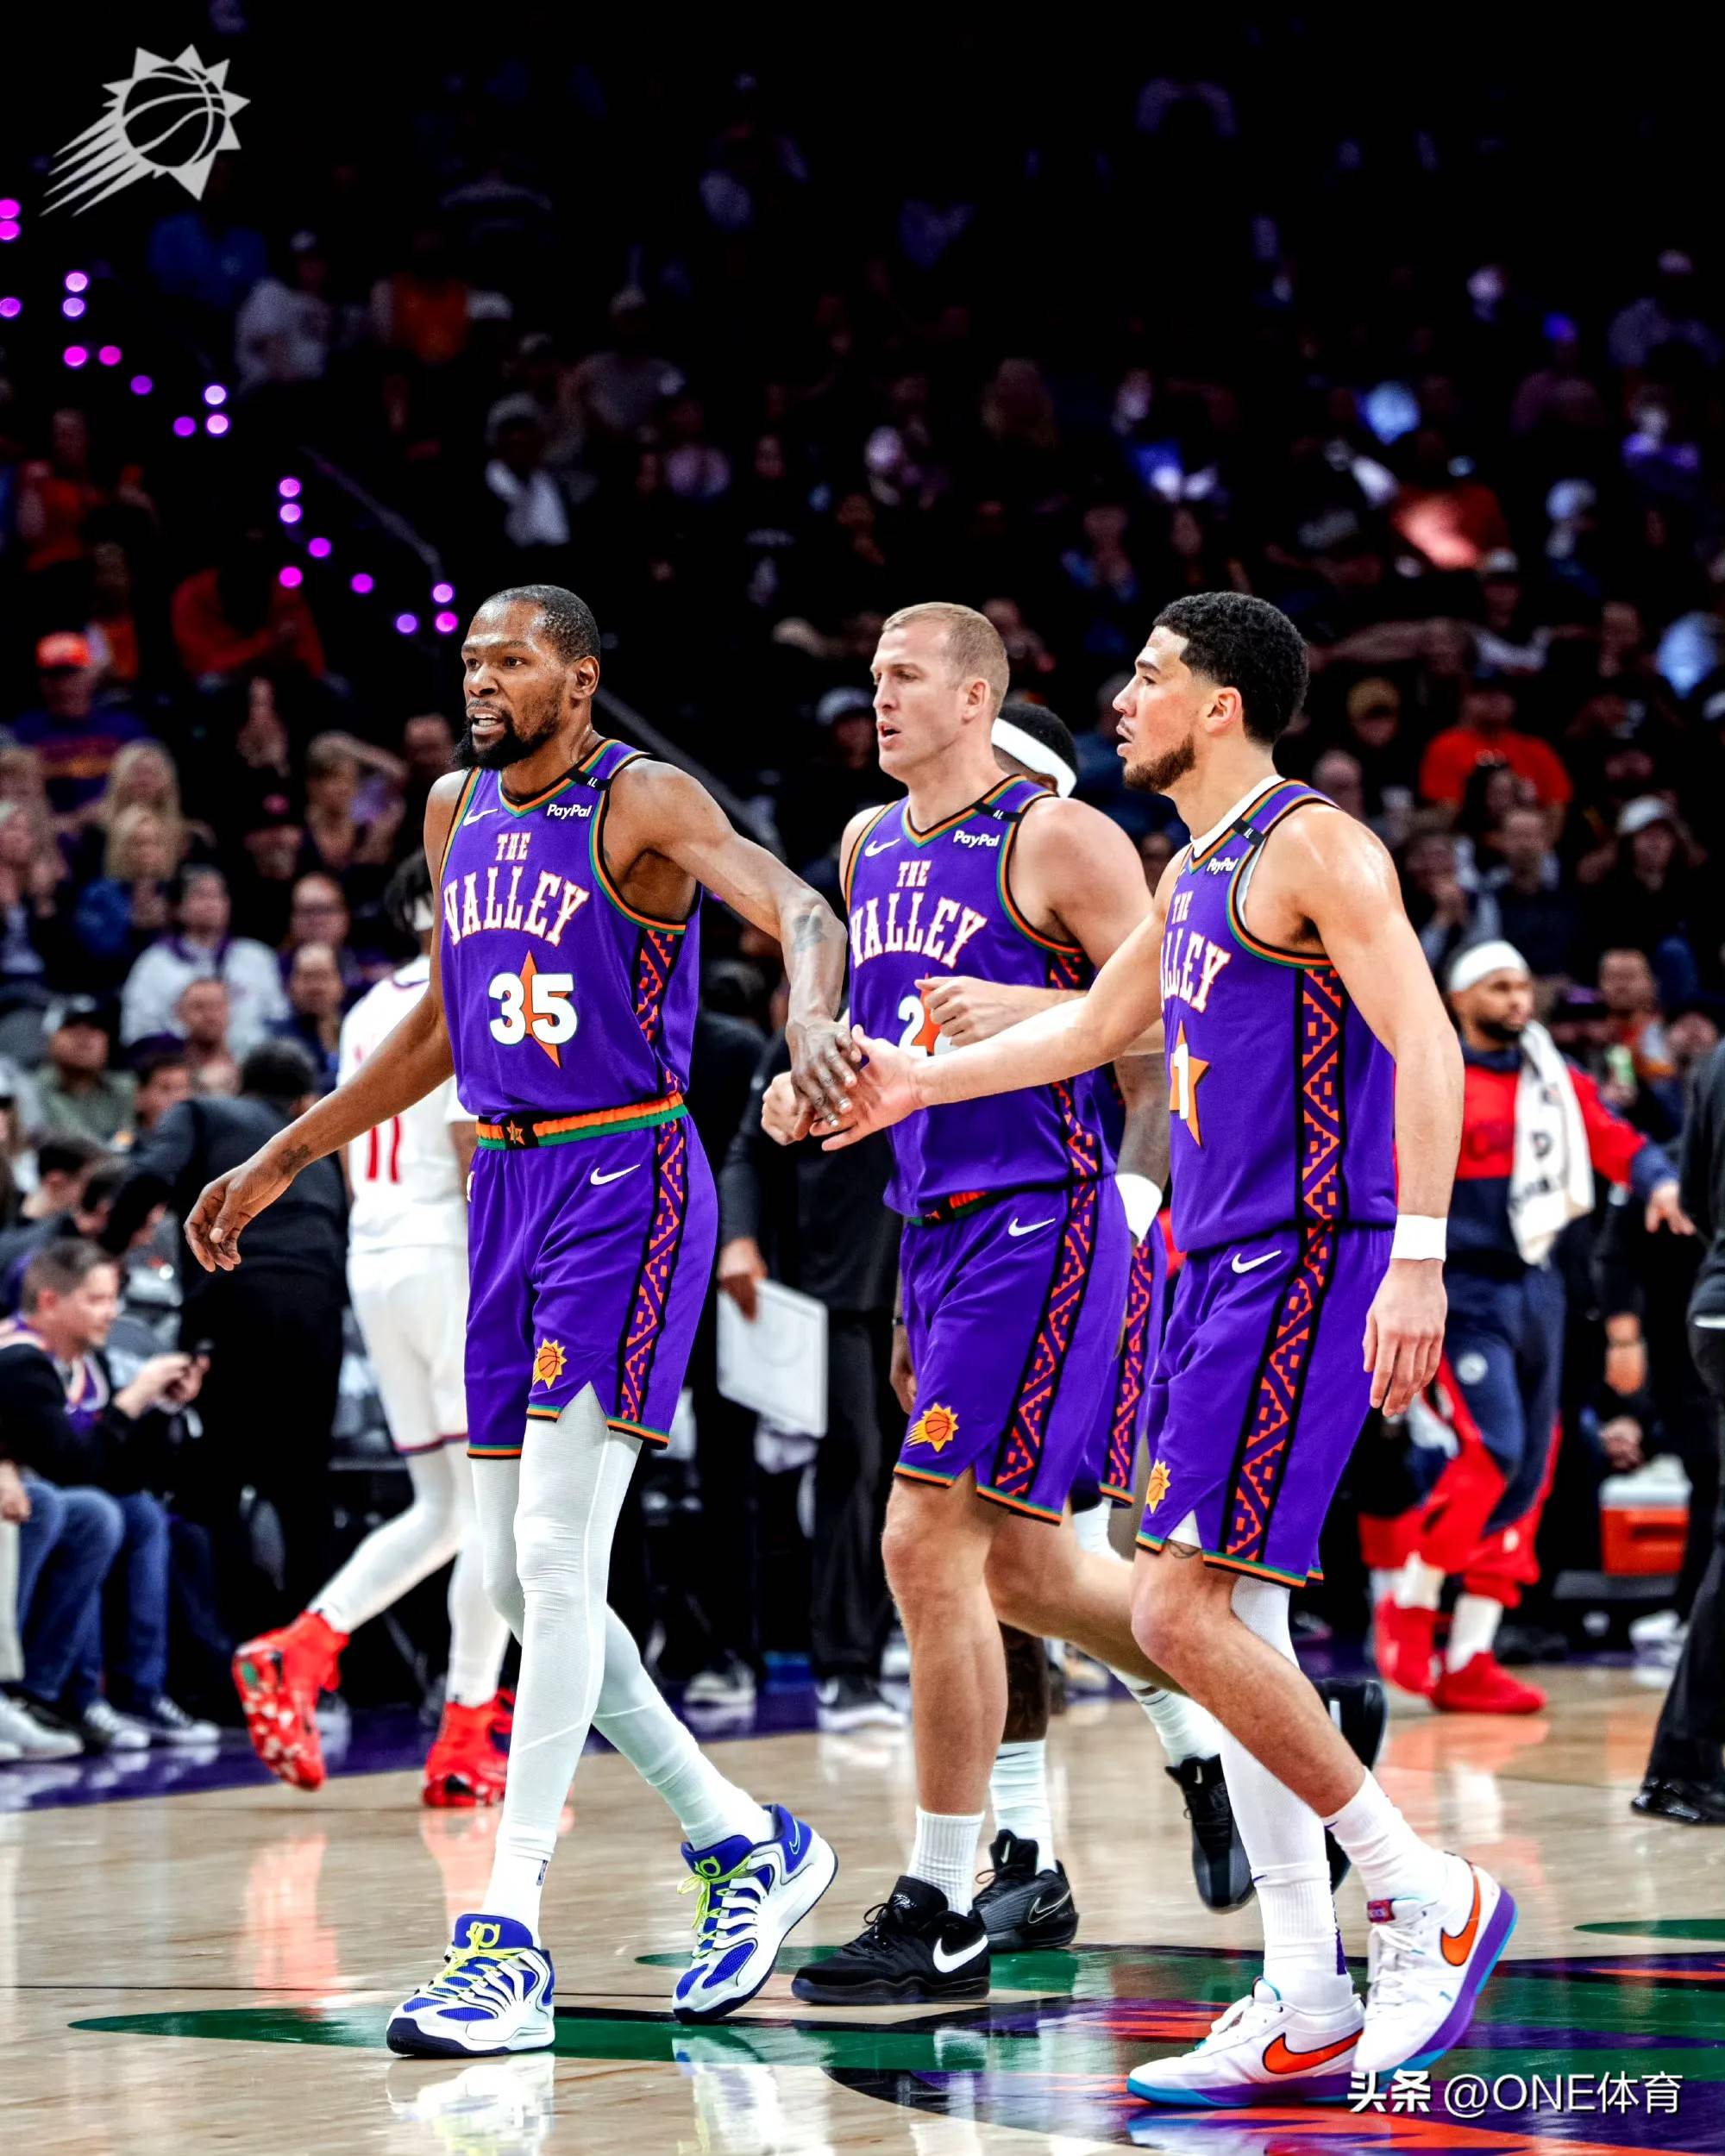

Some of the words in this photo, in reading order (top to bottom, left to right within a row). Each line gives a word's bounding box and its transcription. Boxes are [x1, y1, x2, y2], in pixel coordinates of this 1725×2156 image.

[547, 804, 592, 820] PayPal
[496, 832, 531, 861] THE
[953, 830, 1000, 848] PayPal
[897, 861, 932, 887] THE
[1206, 857, 1239, 875] PayPal
[443, 867, 590, 948] VALLEY
[850, 892, 988, 969] VALLEY
[1170, 890, 1195, 925] THE
[1159, 928, 1232, 1014] LLEY
[488, 973, 578, 1046] 35
[898, 995, 960, 1061] 2
[1173, 1043, 1189, 1119] 1
